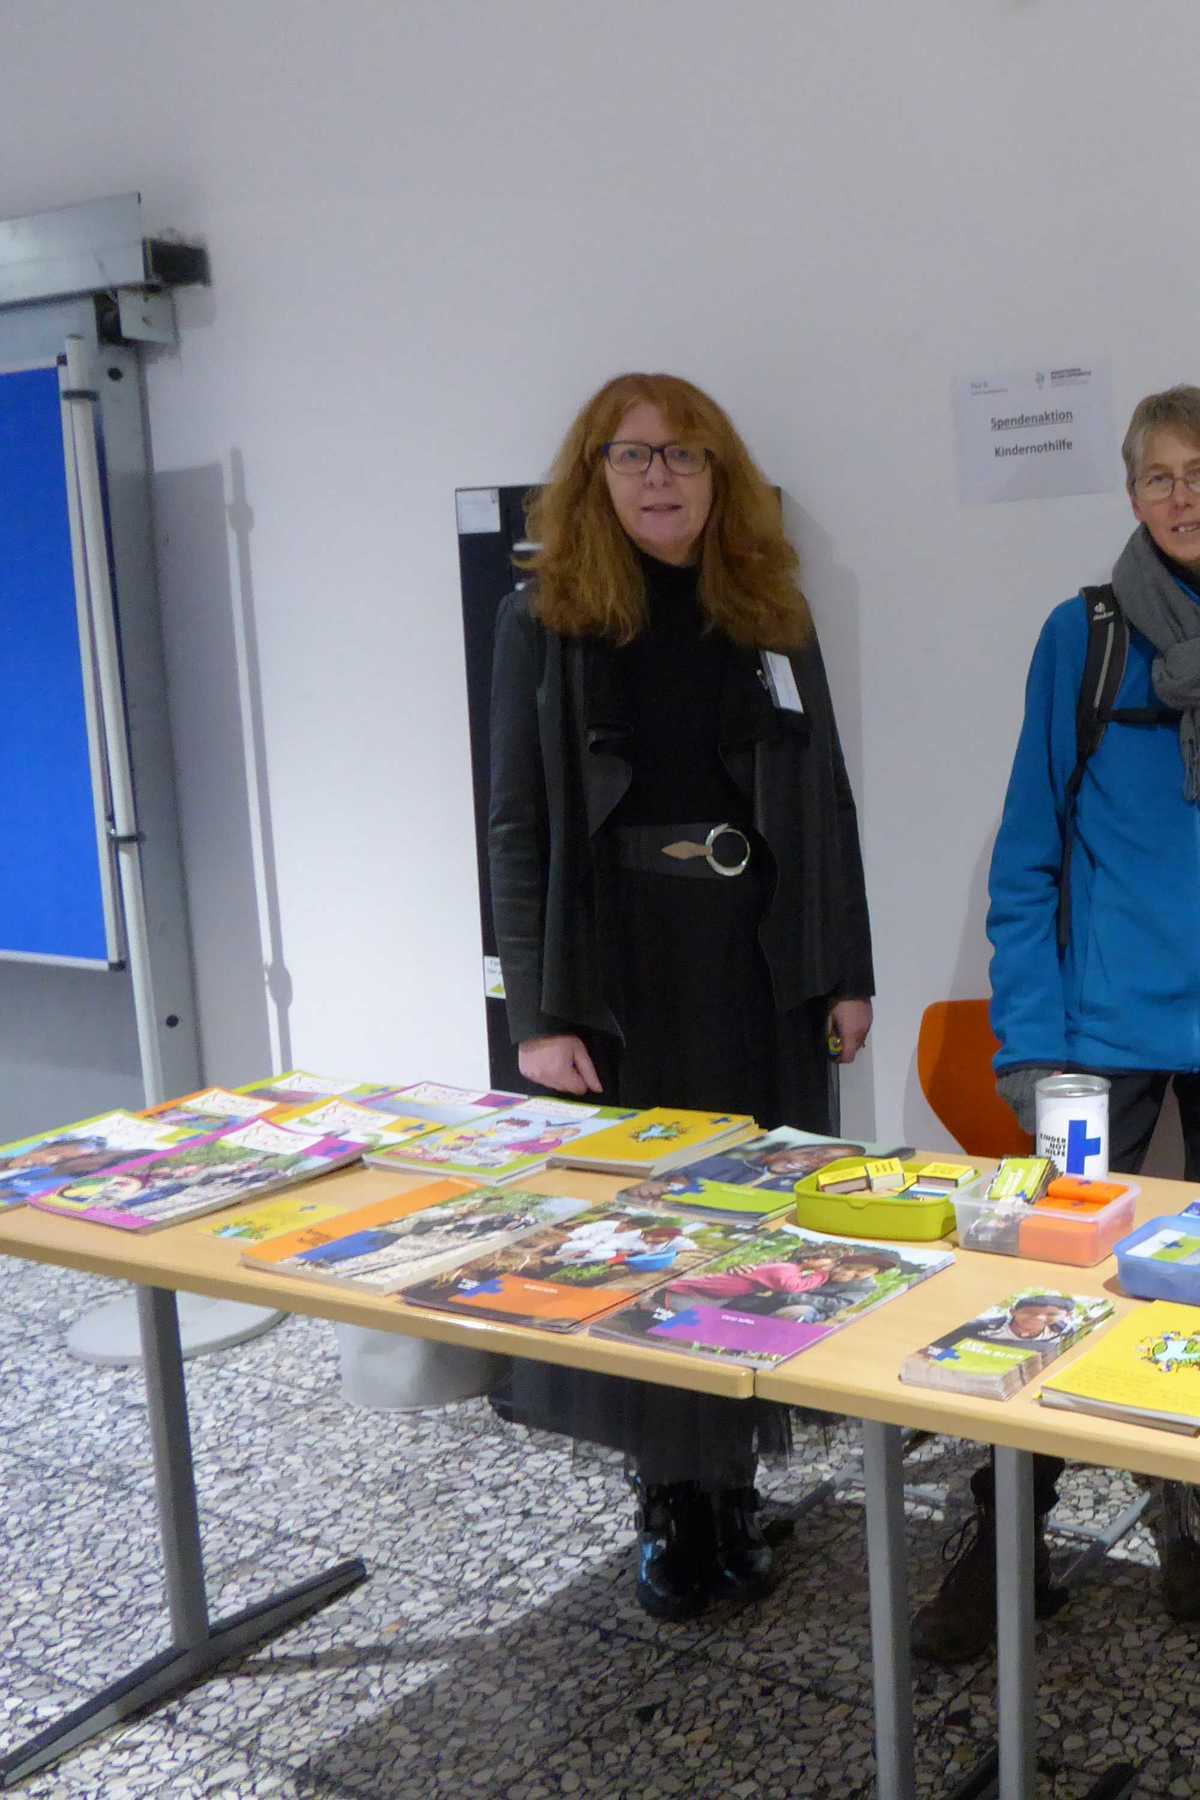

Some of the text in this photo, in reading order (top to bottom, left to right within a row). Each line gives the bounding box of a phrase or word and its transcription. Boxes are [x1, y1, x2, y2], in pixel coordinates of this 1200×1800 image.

[990, 409, 1073, 432] Spendenaktion
[994, 438, 1073, 457] Kindernothilfe
[1045, 1147, 1066, 1157] HILFE
[1050, 1141, 1066, 1150] NOT
